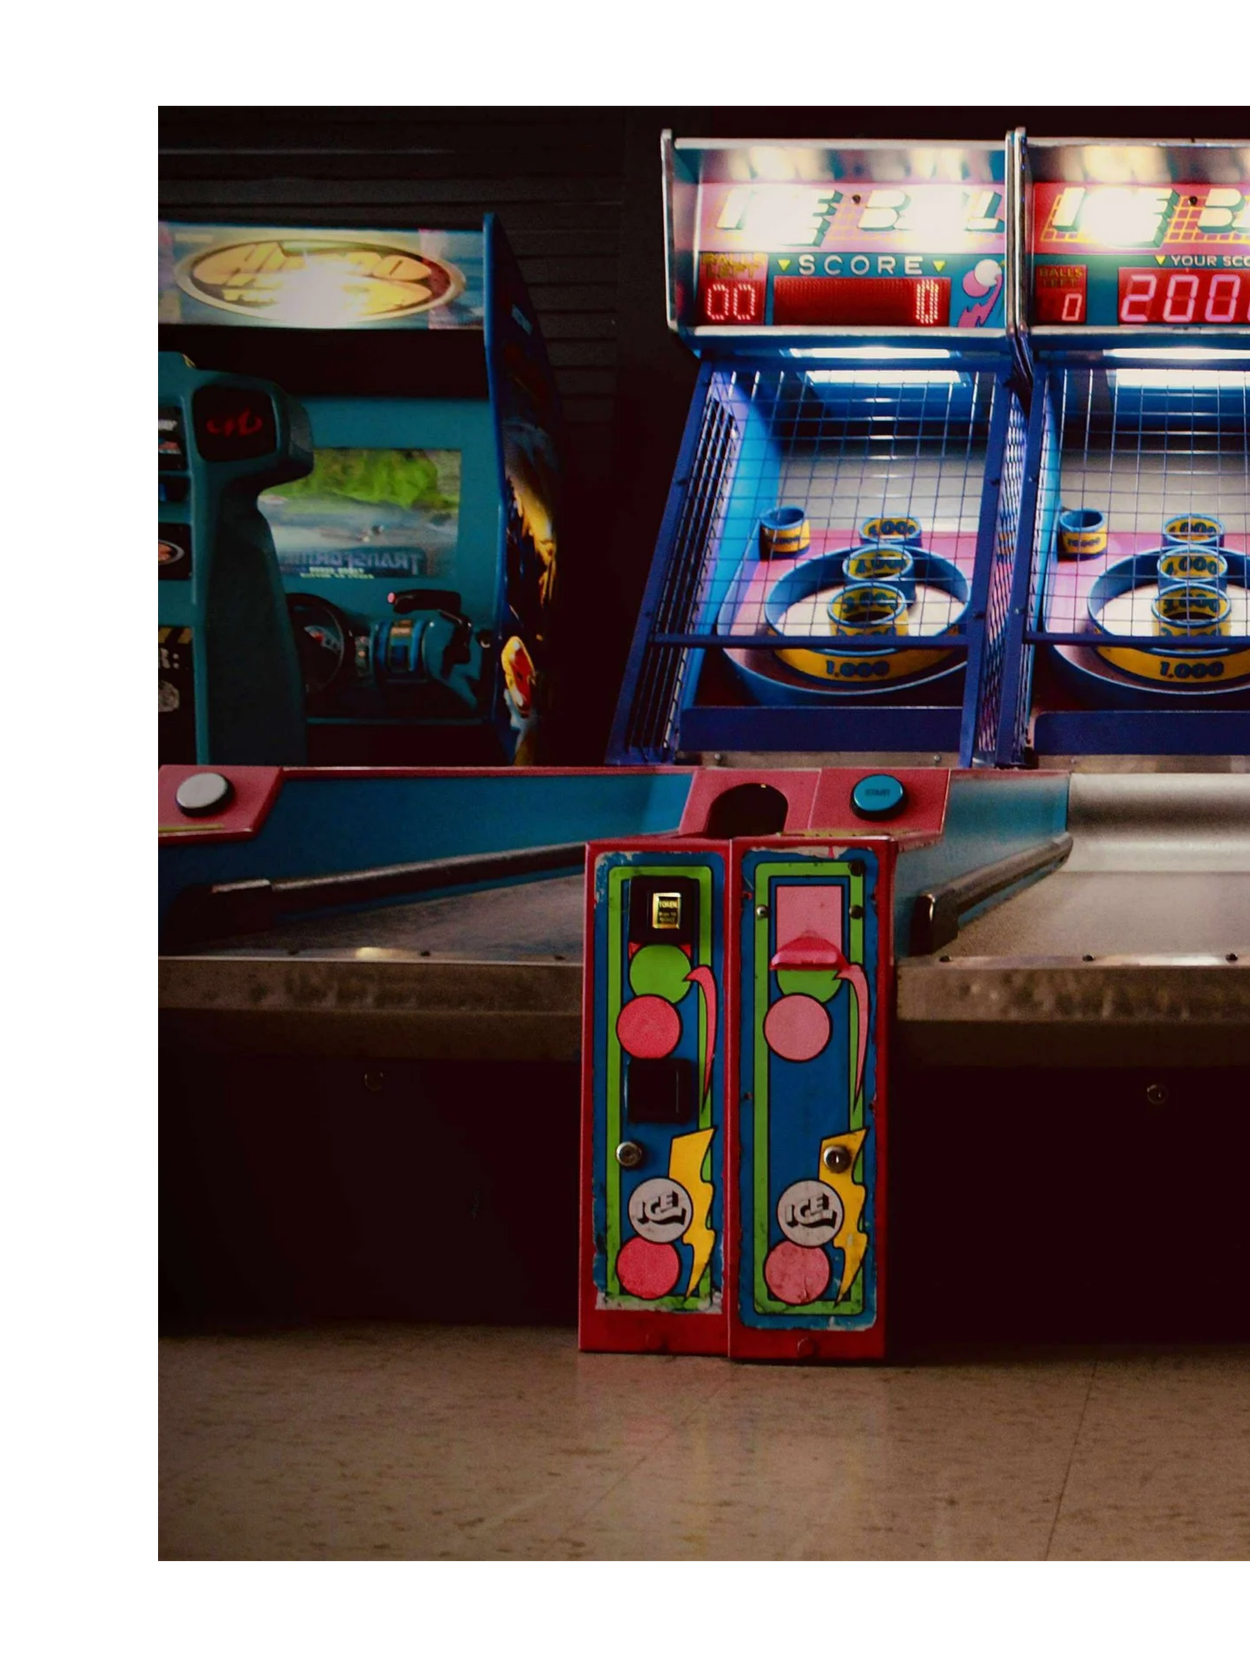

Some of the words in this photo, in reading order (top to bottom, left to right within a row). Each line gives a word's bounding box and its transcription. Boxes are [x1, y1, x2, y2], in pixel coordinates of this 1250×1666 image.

[715, 188, 842, 247] IE
[857, 189, 1004, 232] BL
[1052, 186, 1181, 248] IE
[799, 256, 923, 275] SCORE
[1039, 268, 1083, 277] BALLS
[1171, 255, 1217, 268] YOUR
[706, 283, 756, 321] 00
[1061, 293, 1083, 321] 0
[637, 1191, 687, 1225] ICE
[787, 1194, 838, 1228] ICE
